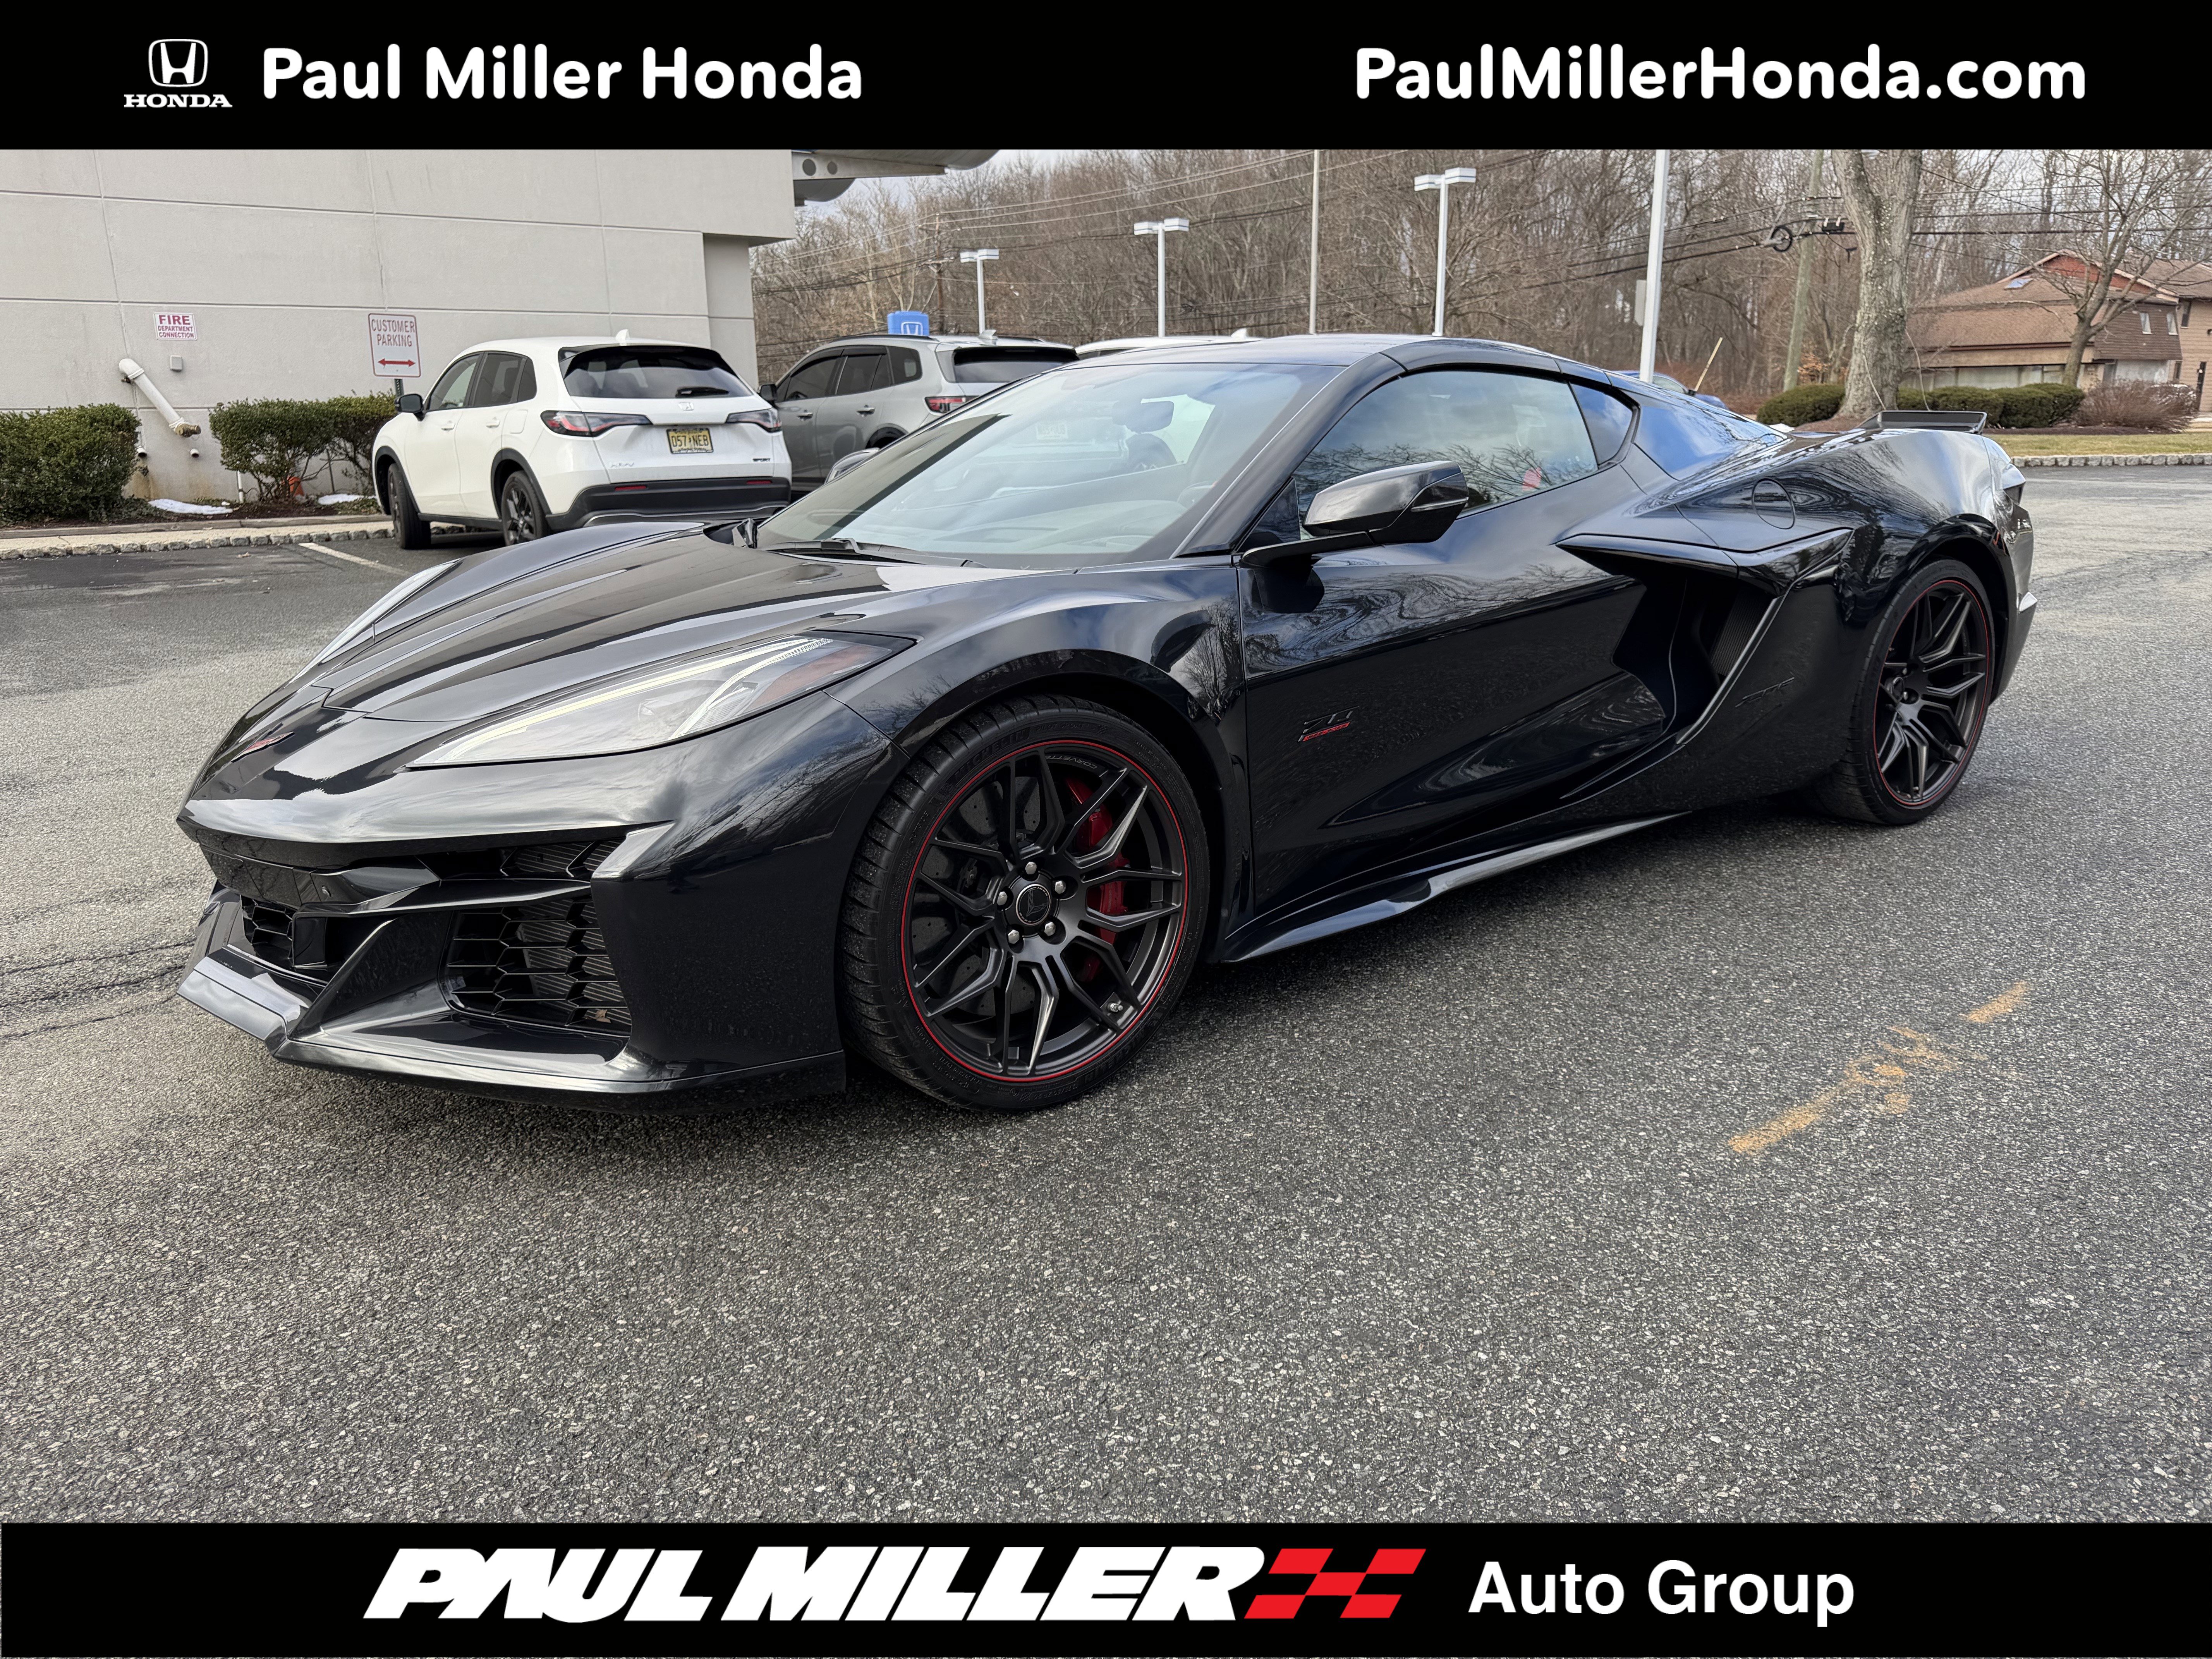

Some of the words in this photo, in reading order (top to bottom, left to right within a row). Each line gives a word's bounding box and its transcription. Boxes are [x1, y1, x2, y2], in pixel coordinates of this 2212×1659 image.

[159, 315, 191, 325] FIRE
[371, 319, 416, 333] CUSTOMER
[377, 333, 412, 347] PARKING
